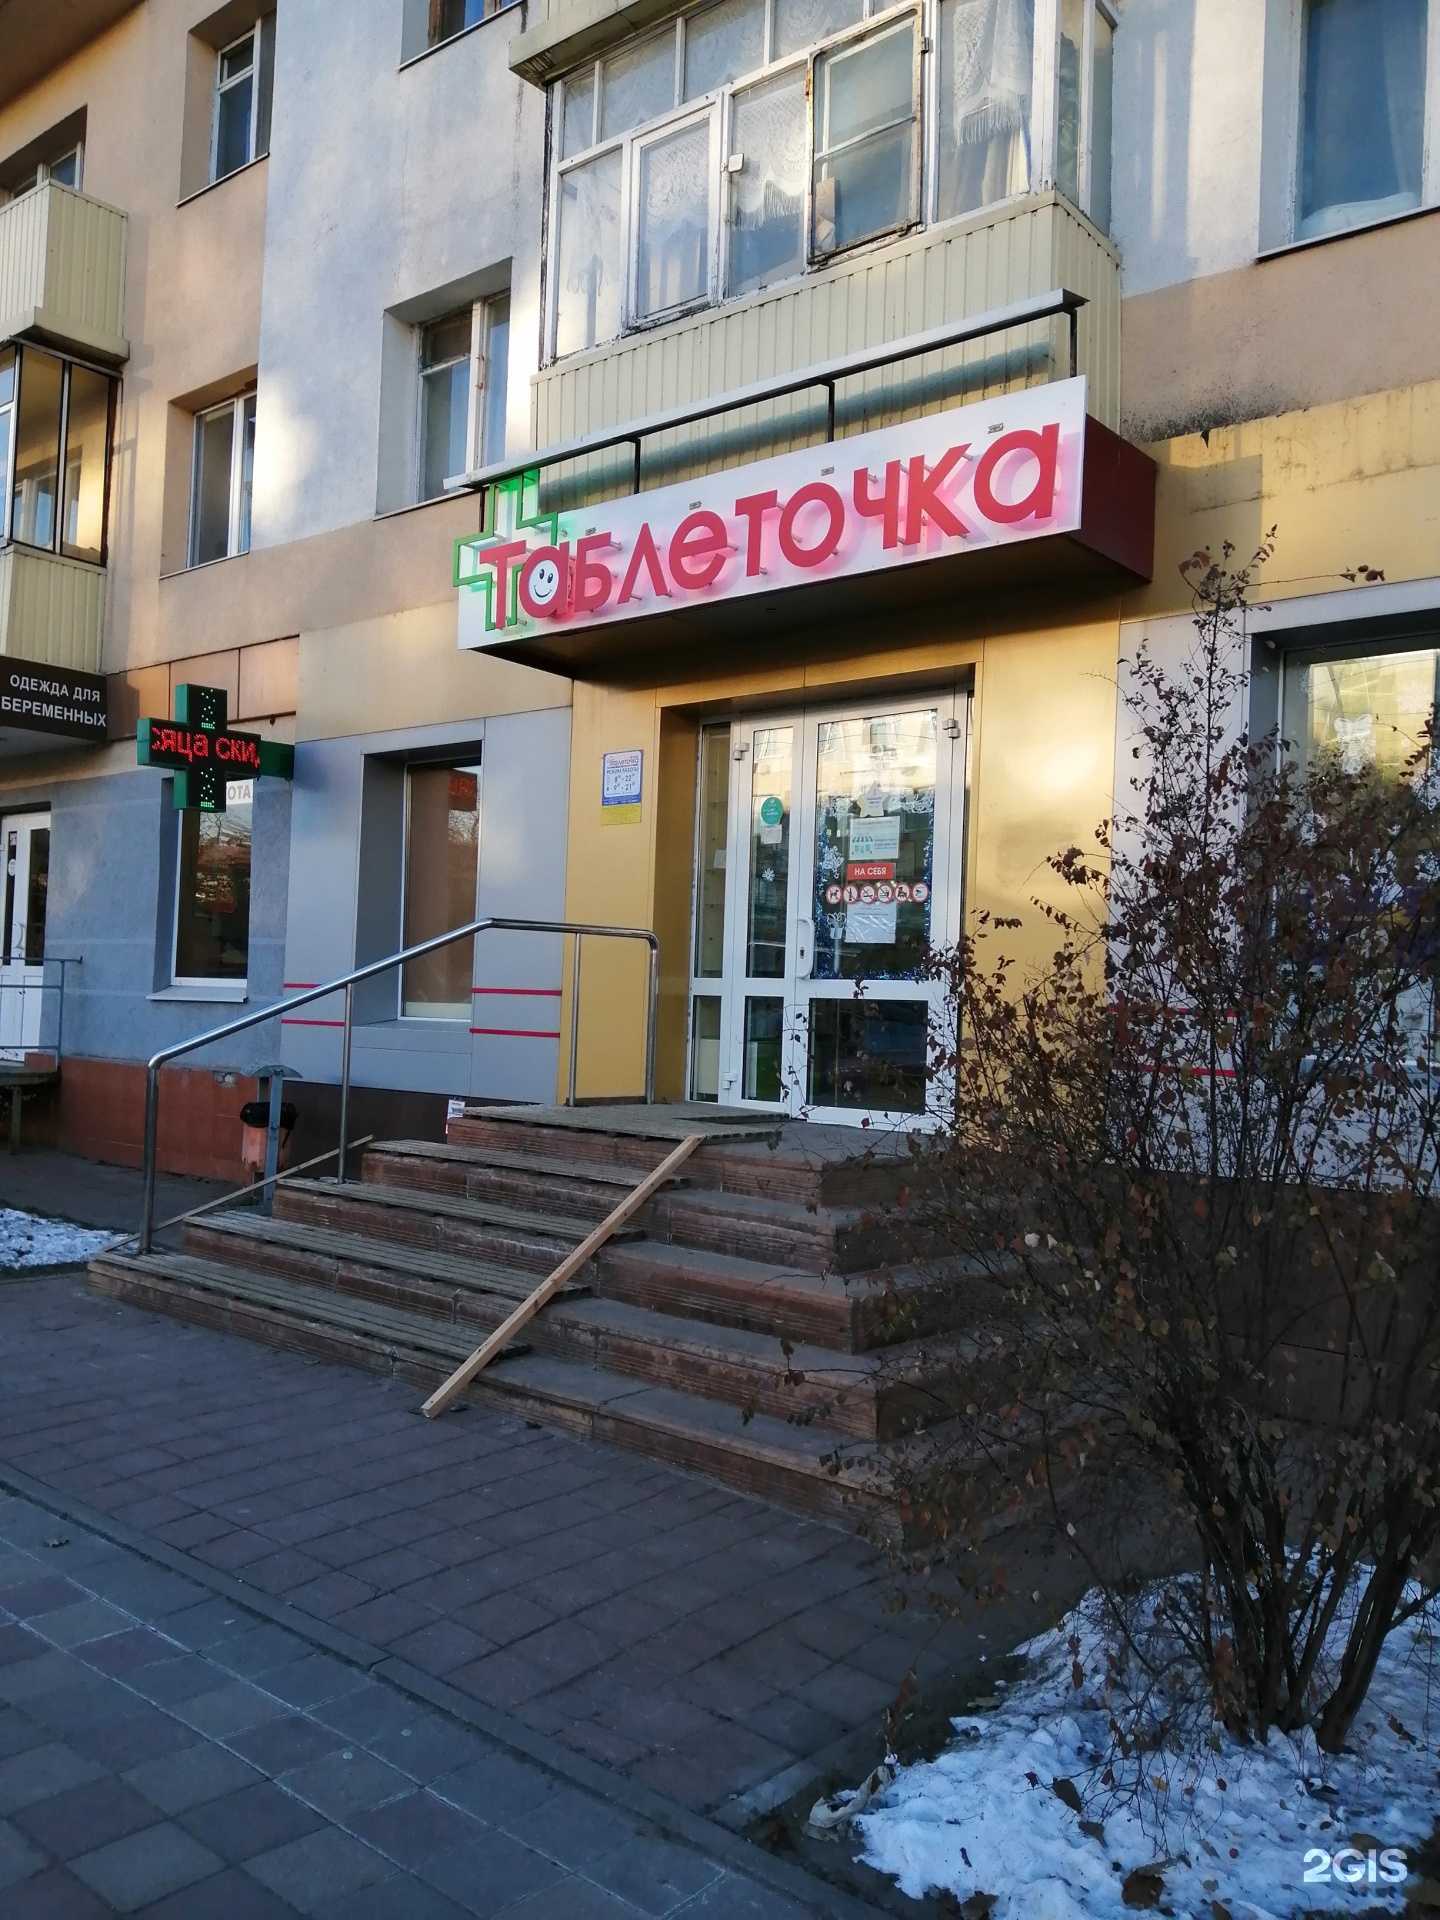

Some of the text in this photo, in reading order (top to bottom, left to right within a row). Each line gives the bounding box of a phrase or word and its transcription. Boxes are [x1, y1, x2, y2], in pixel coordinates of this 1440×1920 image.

[9, 674, 101, 703] ОДЕЖДА ДЛЯ
[1, 695, 107, 727] БЕРЕМЕННЫХ
[854, 866, 887, 876] НА СЕБЯ
